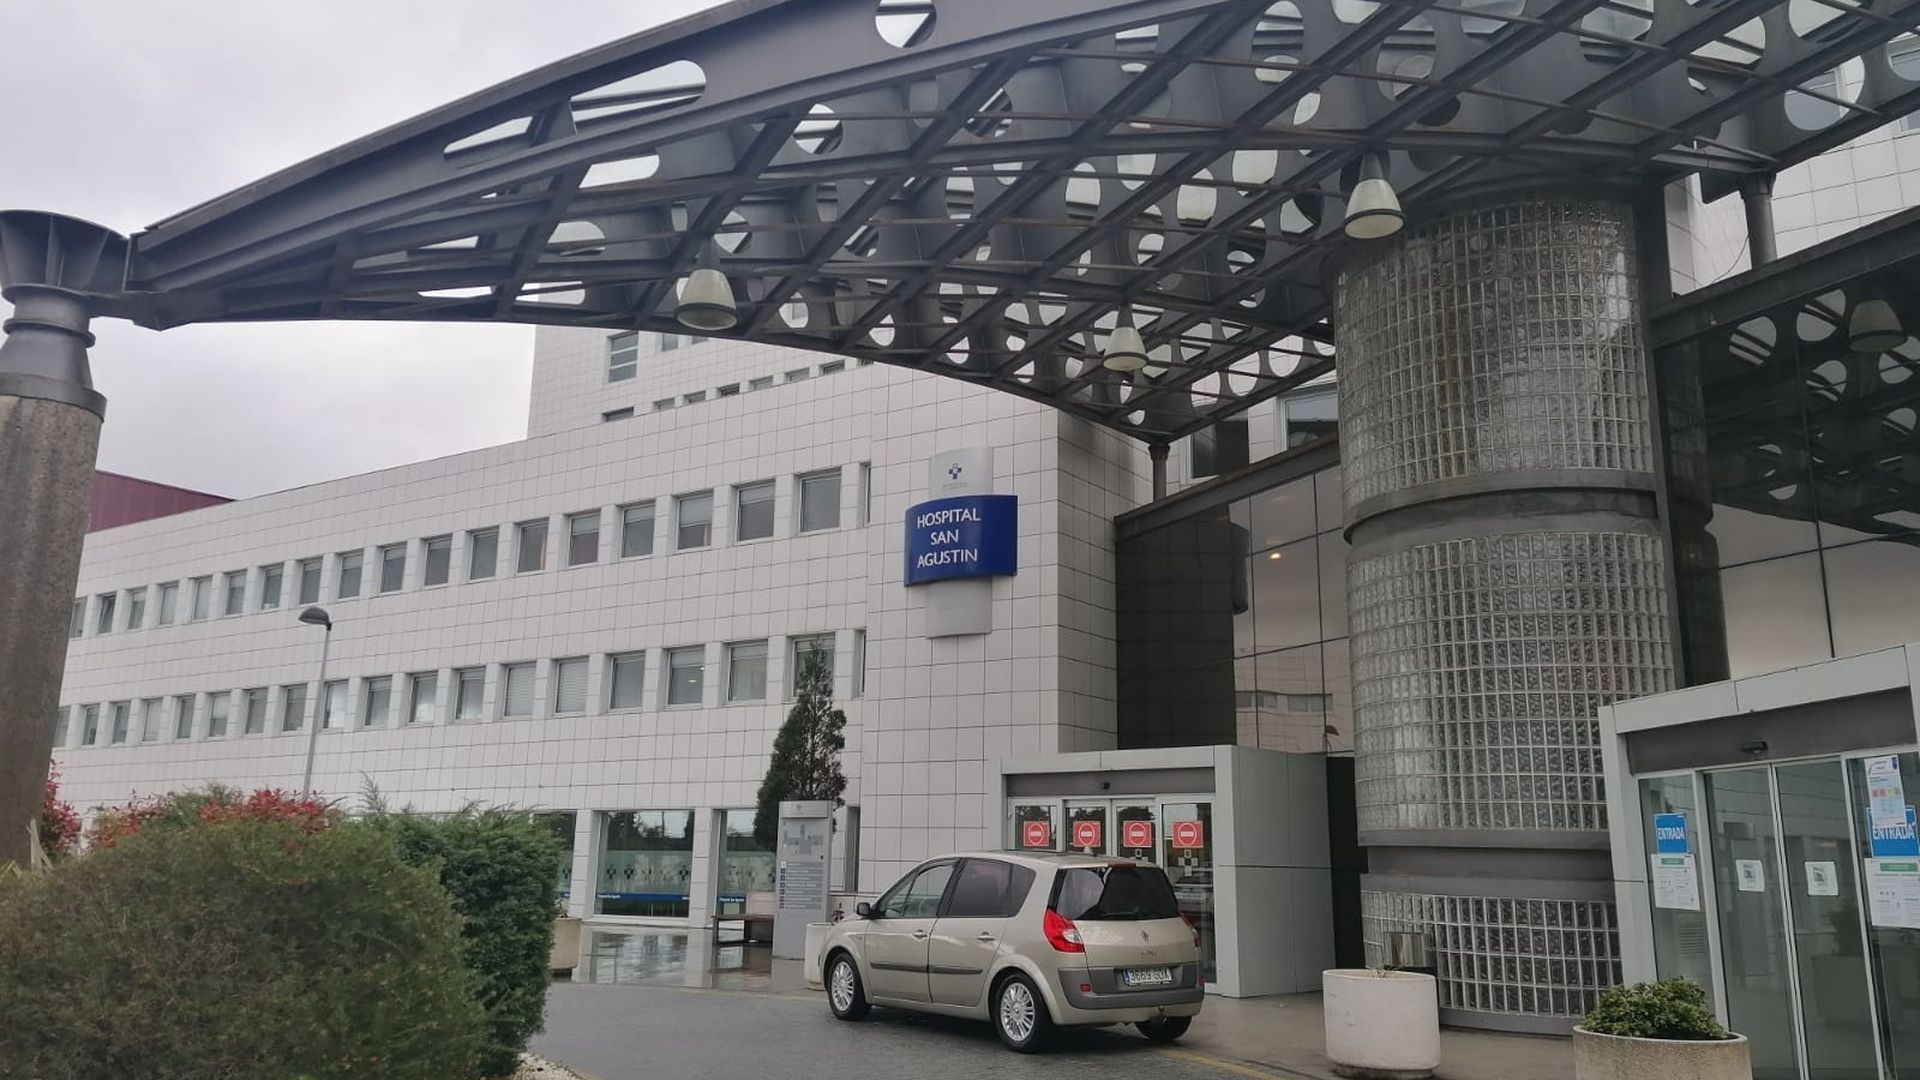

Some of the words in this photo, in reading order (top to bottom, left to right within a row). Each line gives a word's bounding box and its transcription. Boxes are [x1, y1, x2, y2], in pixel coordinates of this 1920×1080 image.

[917, 508, 981, 529] HOSPITAL
[930, 529, 959, 546] SAN
[917, 549, 978, 568] AGUSTIN
[1657, 827, 1686, 840] ENTRADA
[1873, 825, 1915, 840] ENTRADA
